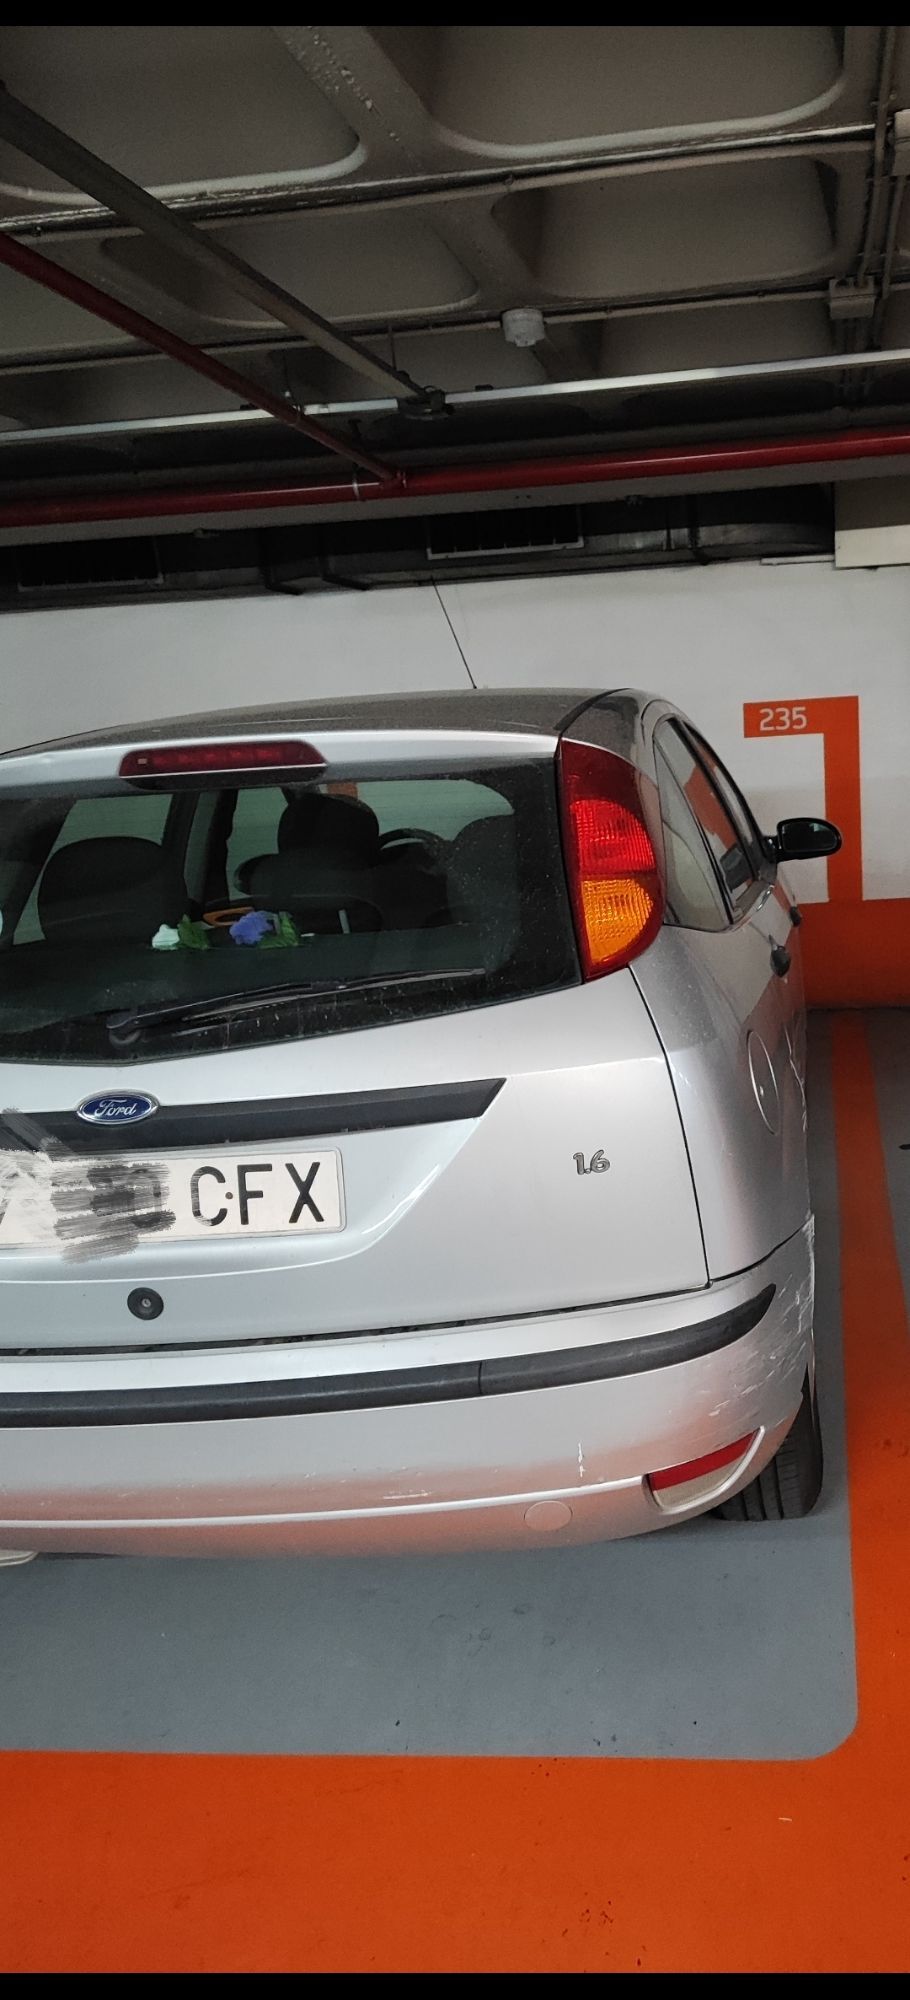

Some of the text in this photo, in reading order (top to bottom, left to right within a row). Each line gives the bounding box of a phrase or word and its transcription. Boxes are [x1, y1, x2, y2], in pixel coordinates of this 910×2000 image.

[759, 707, 808, 731] 235
[94, 1098, 137, 1117] Ford
[572, 1149, 611, 1175] 1.6
[191, 1162, 325, 1226] CFX
